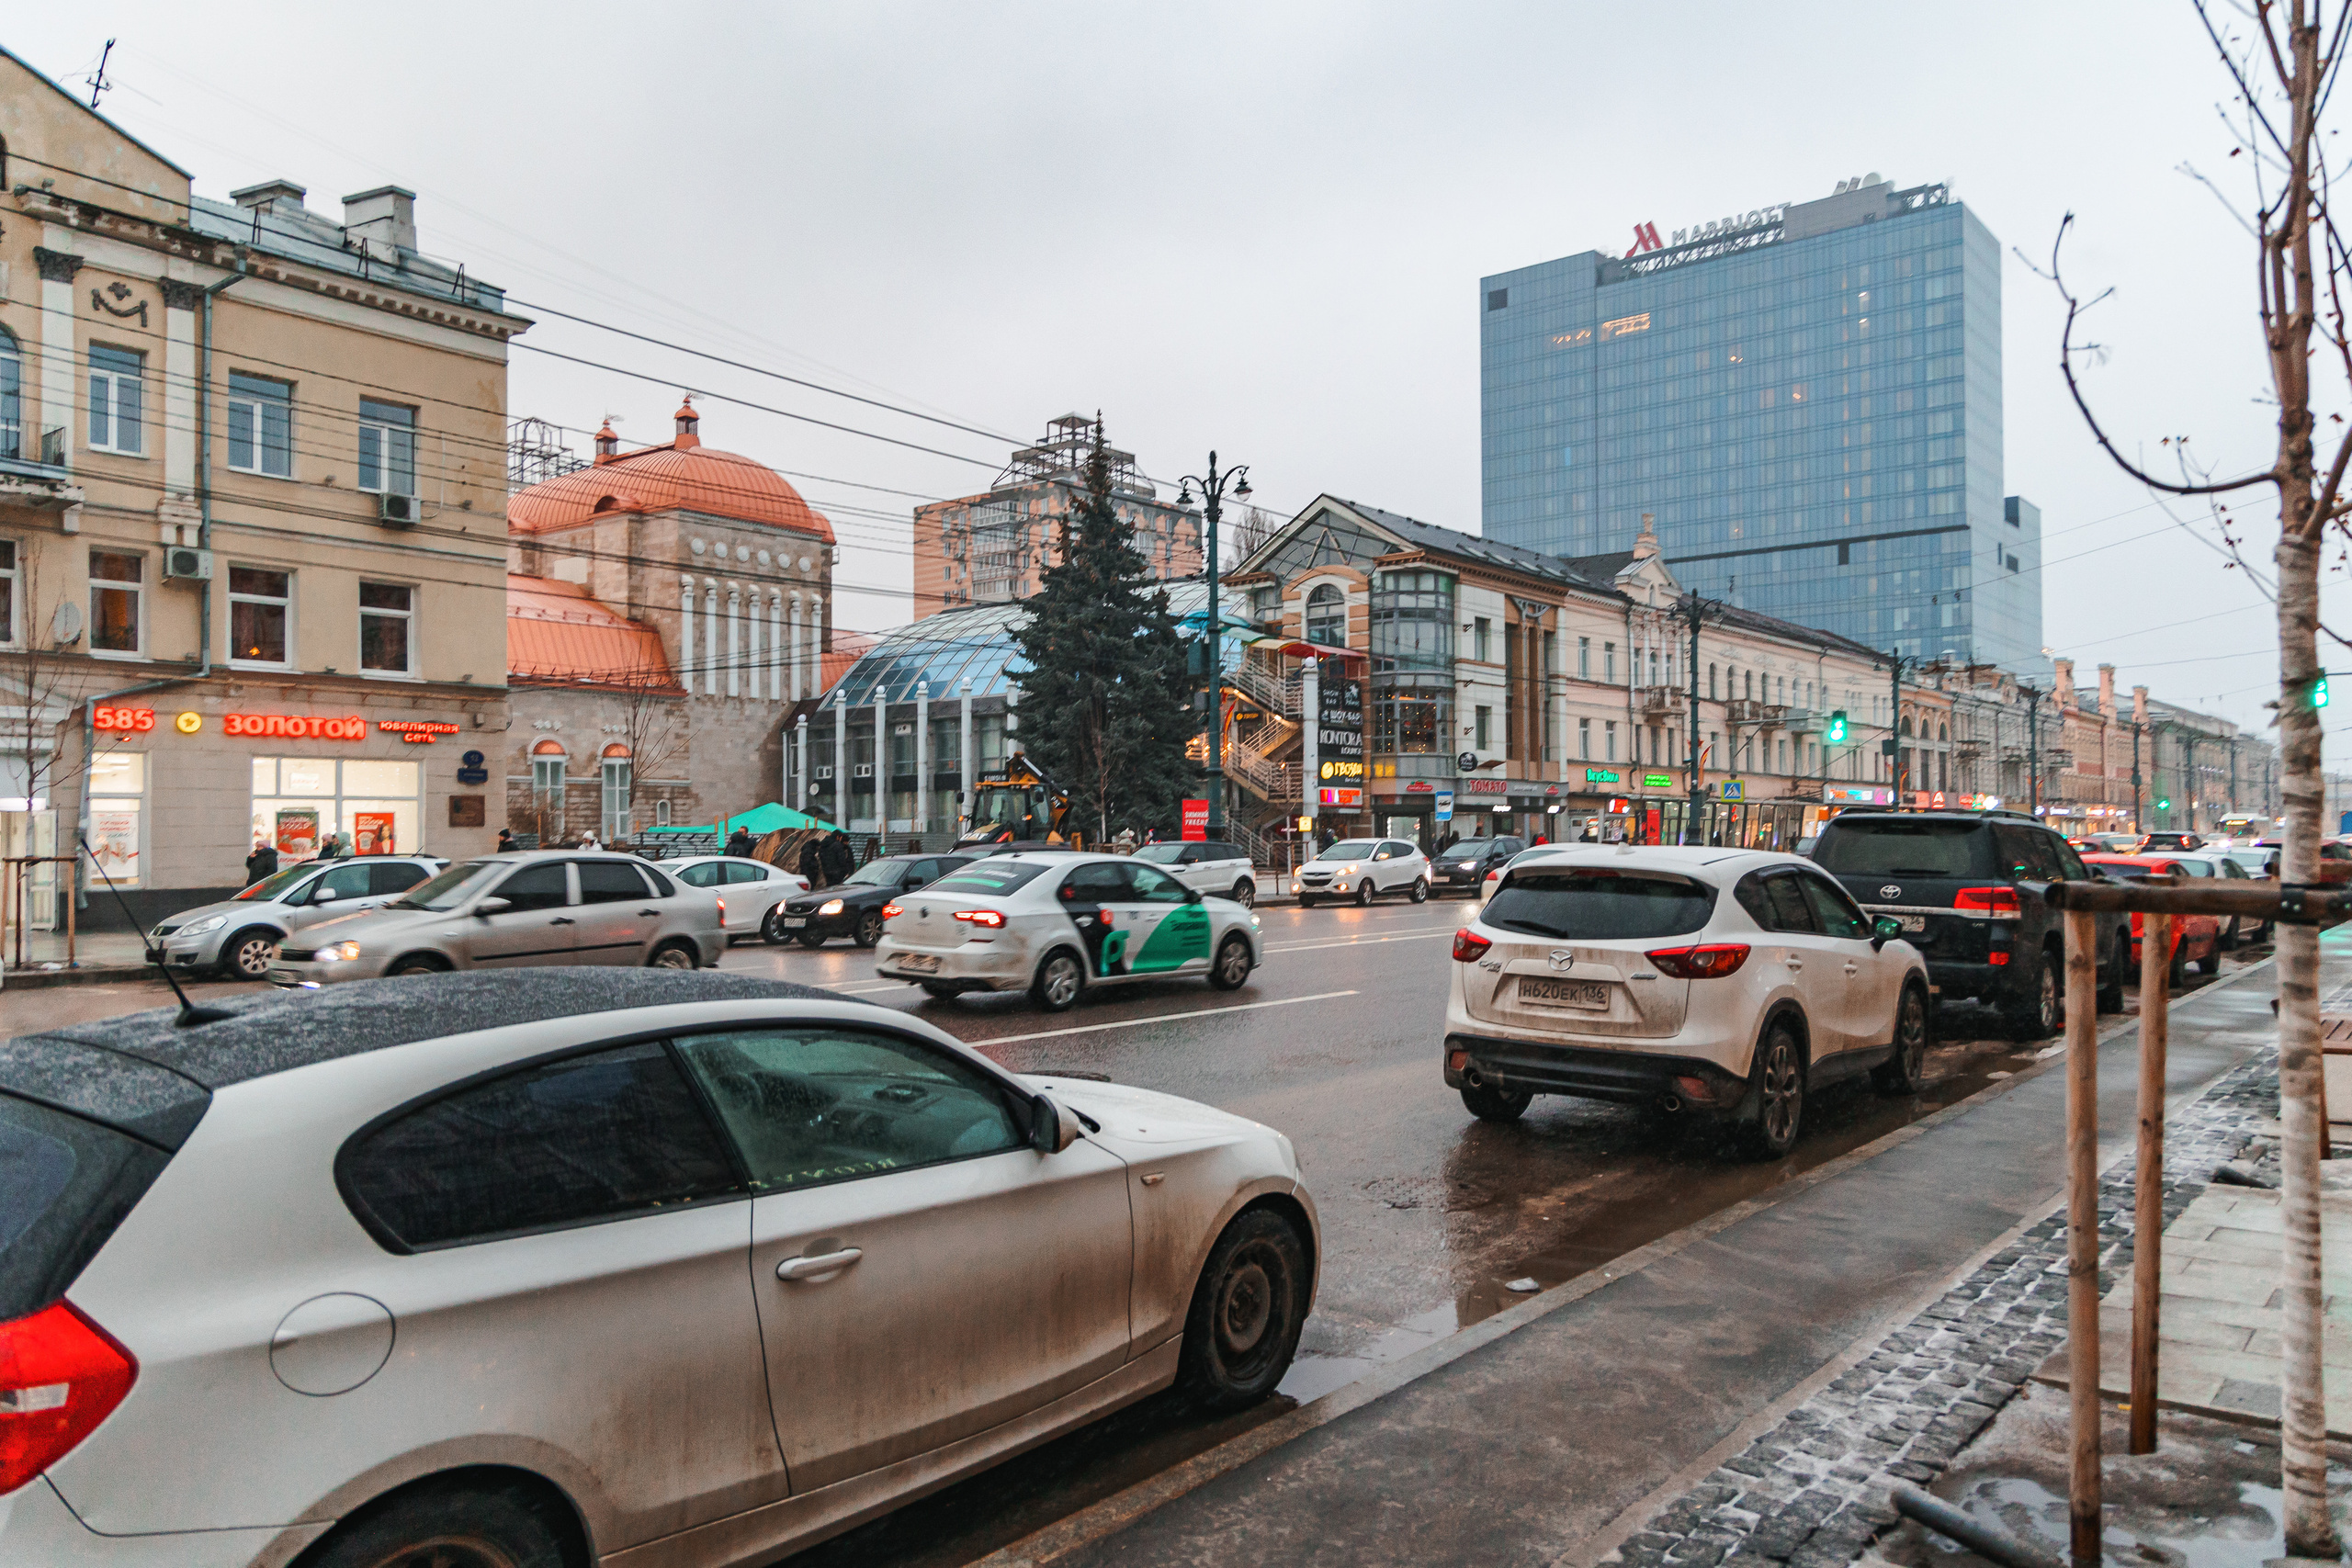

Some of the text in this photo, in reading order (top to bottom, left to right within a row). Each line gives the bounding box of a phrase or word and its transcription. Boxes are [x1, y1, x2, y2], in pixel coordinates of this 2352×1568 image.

[1671, 201, 1792, 247] MARRIOTT
[94, 706, 367, 739] 585 ЗОЛОТОЙ
[1319, 729, 1363, 746] KONTORA
[1470, 780, 1507, 793] TOMATO
[1582, 986, 1605, 999] 136
